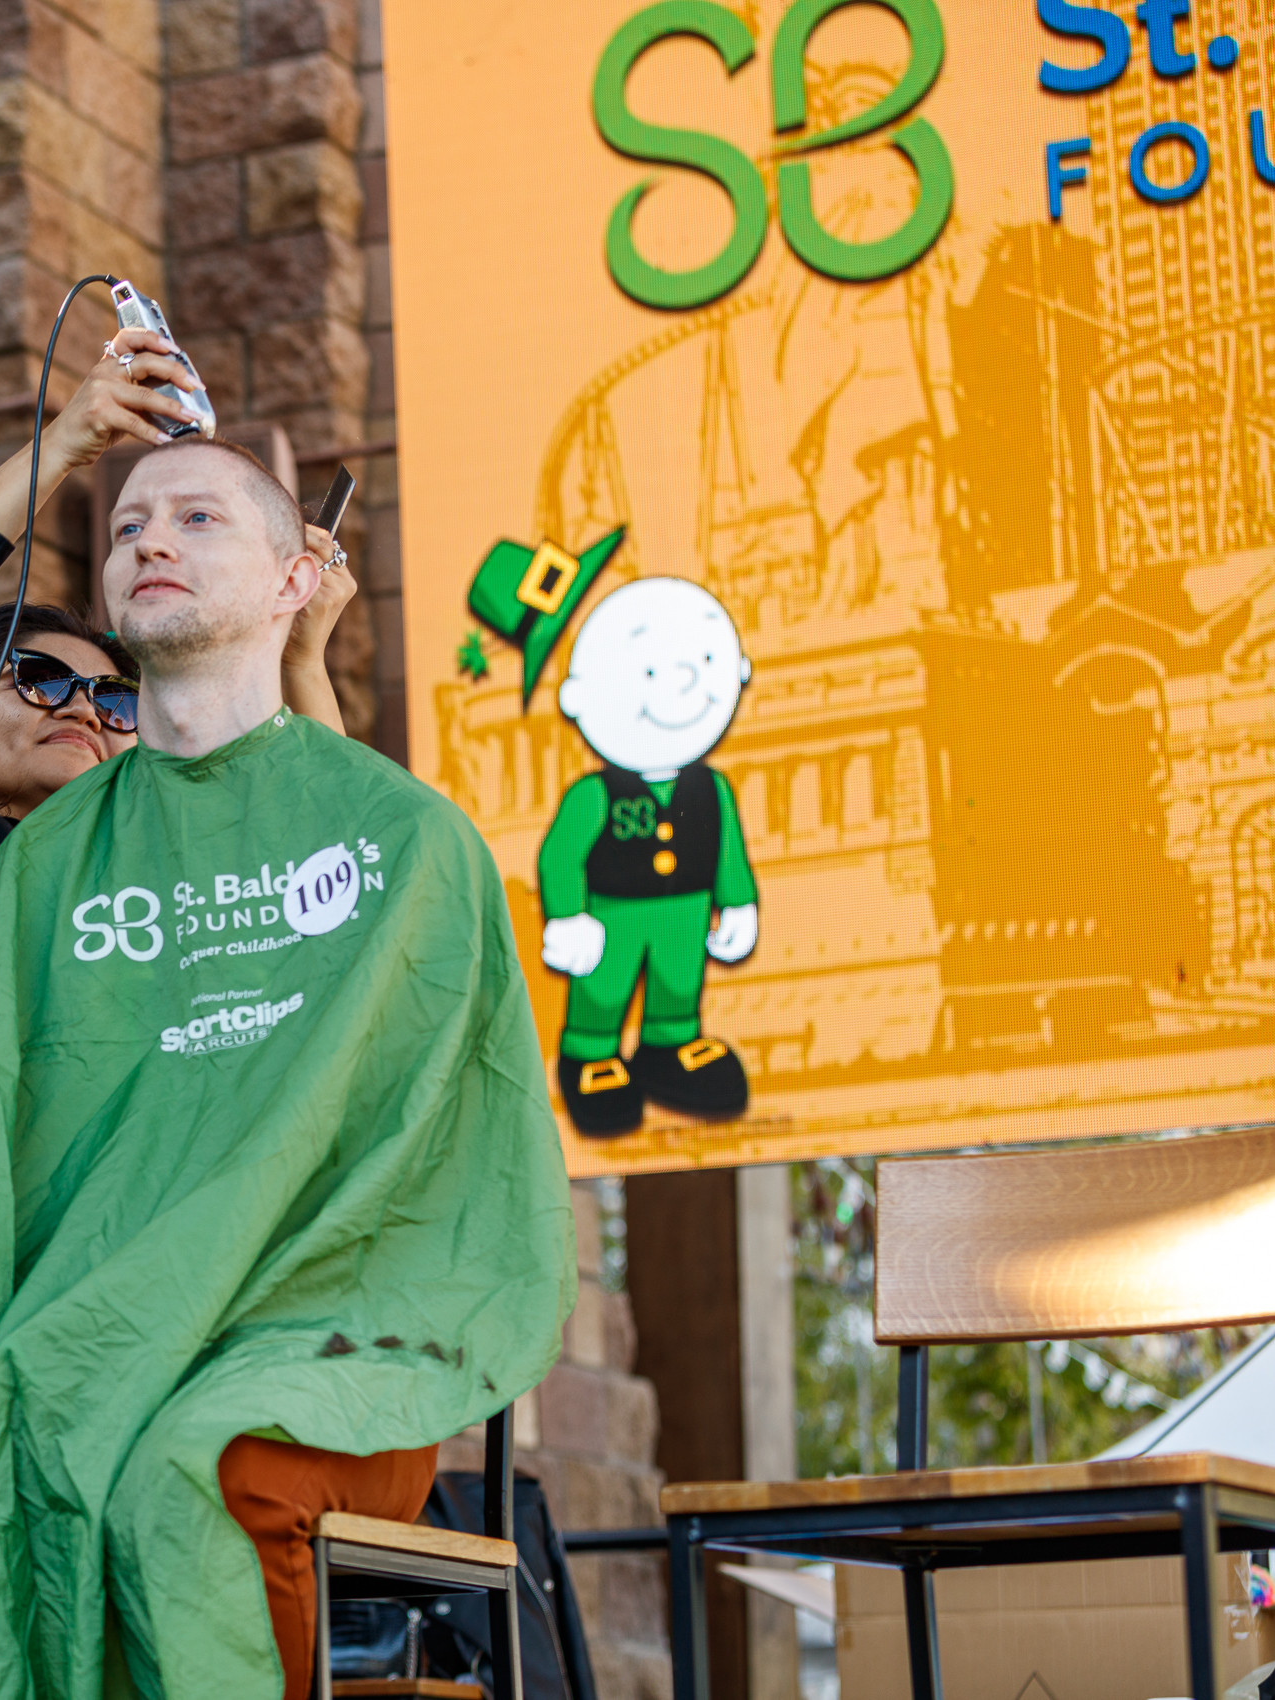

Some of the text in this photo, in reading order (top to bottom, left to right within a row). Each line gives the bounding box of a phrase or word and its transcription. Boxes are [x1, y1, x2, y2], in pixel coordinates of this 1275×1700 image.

[1037, 0, 1239, 94] St.
[173, 837, 381, 916] St. Bald's
[295, 861, 351, 917] 109
[176, 871, 384, 945] FOUNDN
[179, 932, 303, 970] Cquer Childhood
[190, 990, 226, 1008] Ntional
[186, 1028, 268, 1055] HARCUTS
